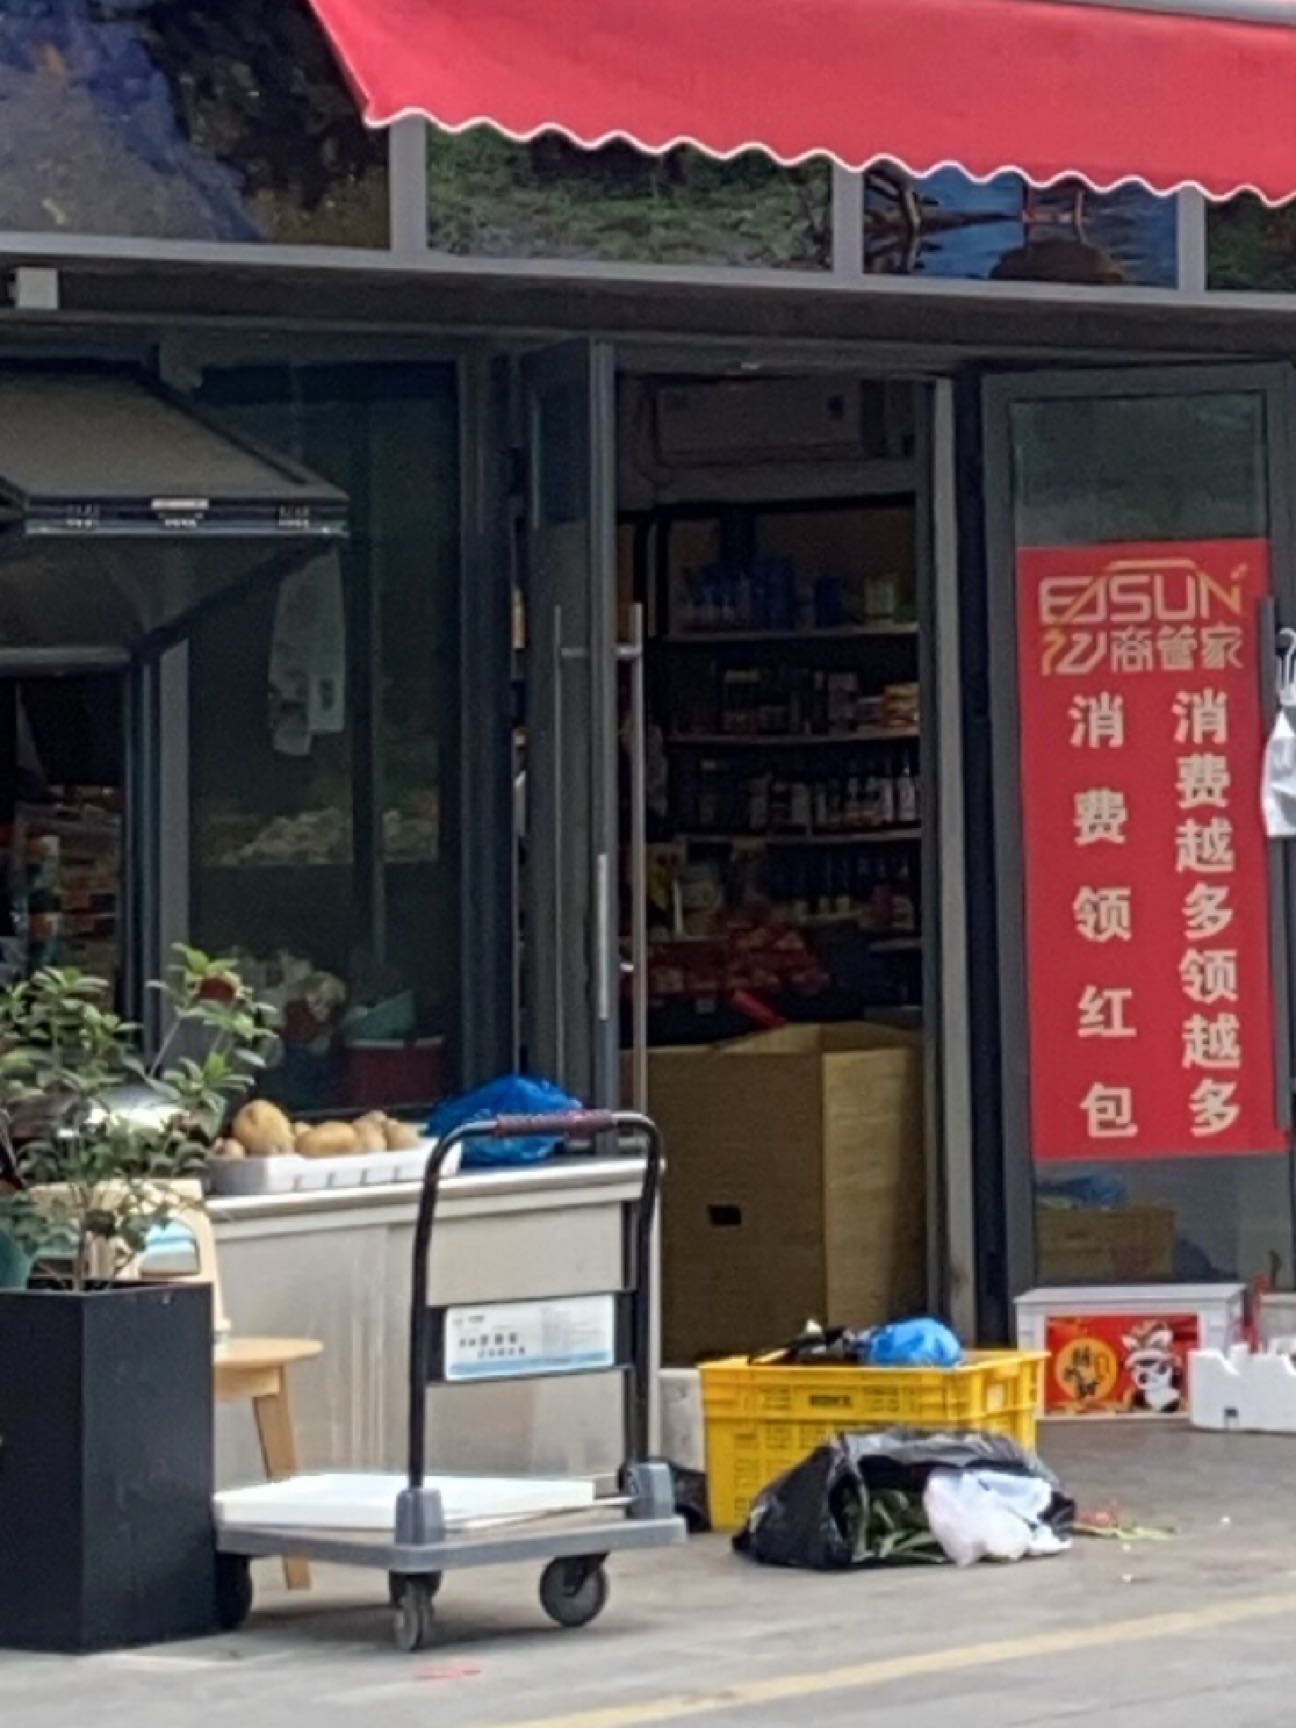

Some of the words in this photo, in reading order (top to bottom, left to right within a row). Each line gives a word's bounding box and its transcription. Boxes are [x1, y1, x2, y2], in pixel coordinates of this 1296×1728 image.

[1039, 560, 1247, 625] EASUN
[1068, 691, 1138, 1140] 消费领红包
[1172, 688, 1243, 1138] 消费越多领越多
